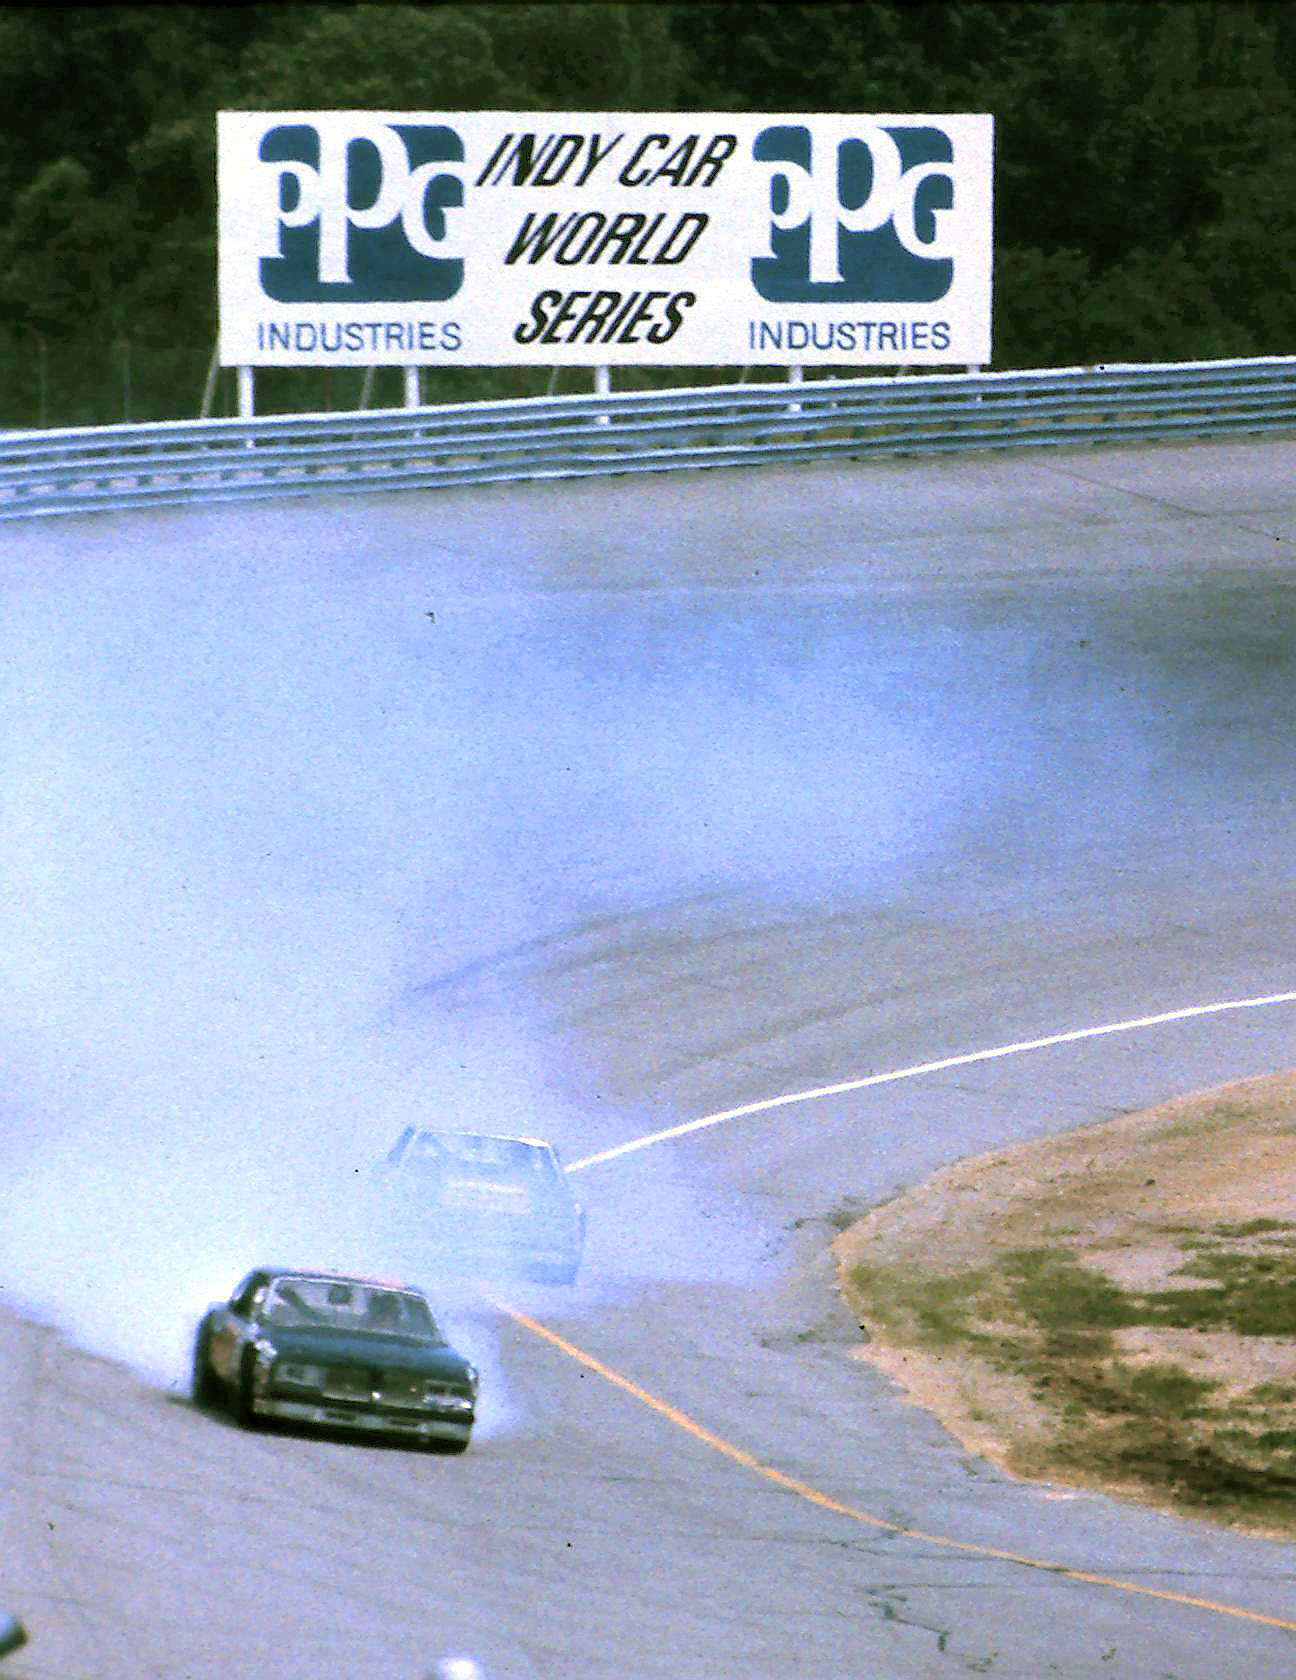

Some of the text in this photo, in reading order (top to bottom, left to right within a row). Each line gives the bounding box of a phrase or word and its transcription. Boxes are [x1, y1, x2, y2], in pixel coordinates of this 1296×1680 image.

[476, 134, 738, 187] INDY CAR
[505, 212, 709, 265] WORLD
[258, 322, 462, 352] INDUSTRIES
[514, 290, 696, 345] SERIES
[750, 321, 952, 351] INDUSTRIES
